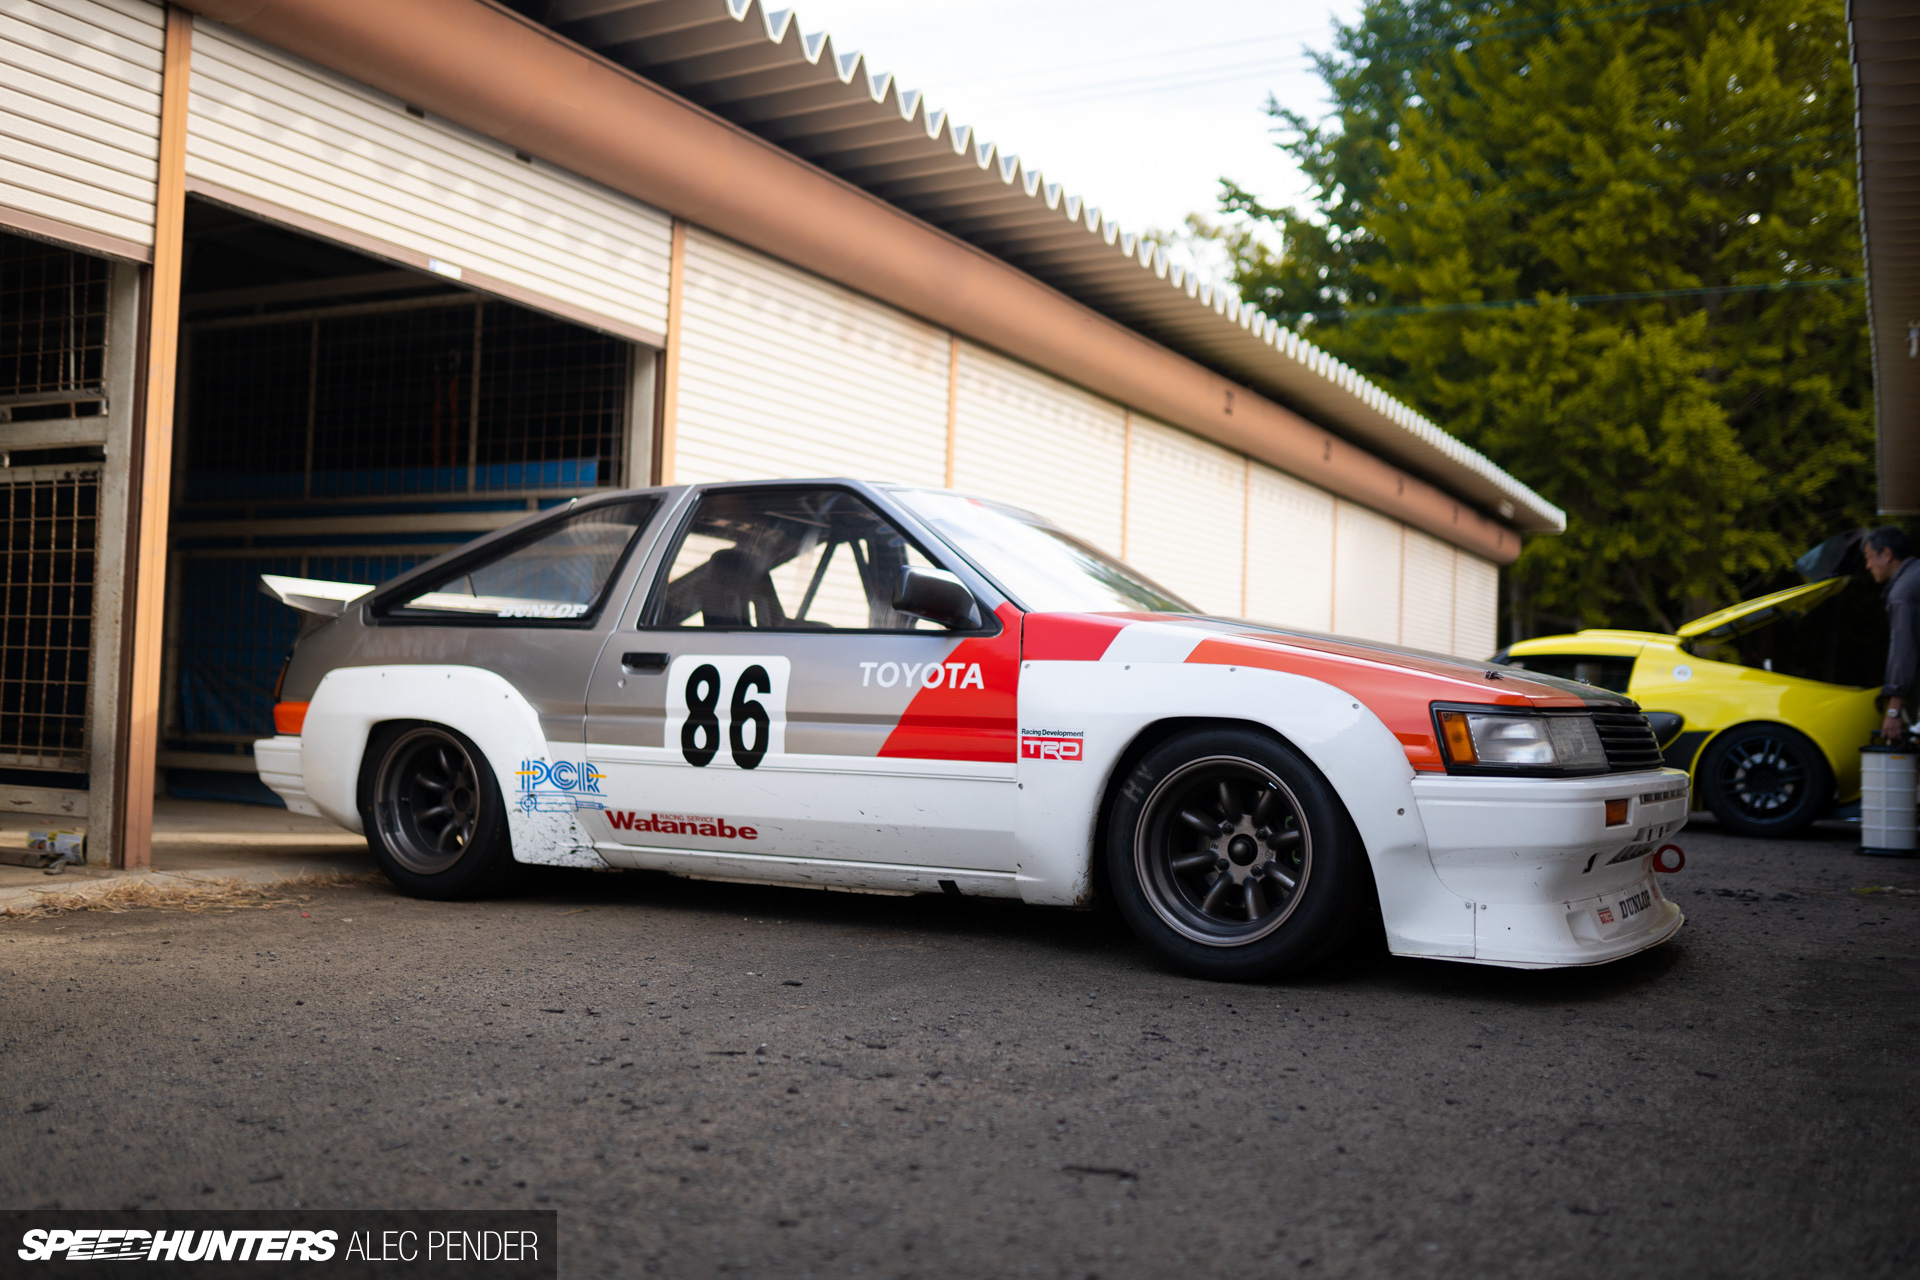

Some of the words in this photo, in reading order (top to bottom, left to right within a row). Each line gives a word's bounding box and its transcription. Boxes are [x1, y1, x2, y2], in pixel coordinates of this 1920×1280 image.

[498, 604, 588, 618] DUNLOP
[859, 662, 985, 689] TOYOTA
[681, 664, 771, 770] 86
[1021, 728, 1041, 737] Racing
[1042, 729, 1084, 738] Development
[1023, 740, 1080, 761] TRD
[521, 760, 602, 793] PCR
[605, 810, 758, 840] Watanabe
[660, 813, 685, 821] RACING
[687, 815, 715, 823] SERVICE
[1619, 890, 1651, 919] DUNLOP
